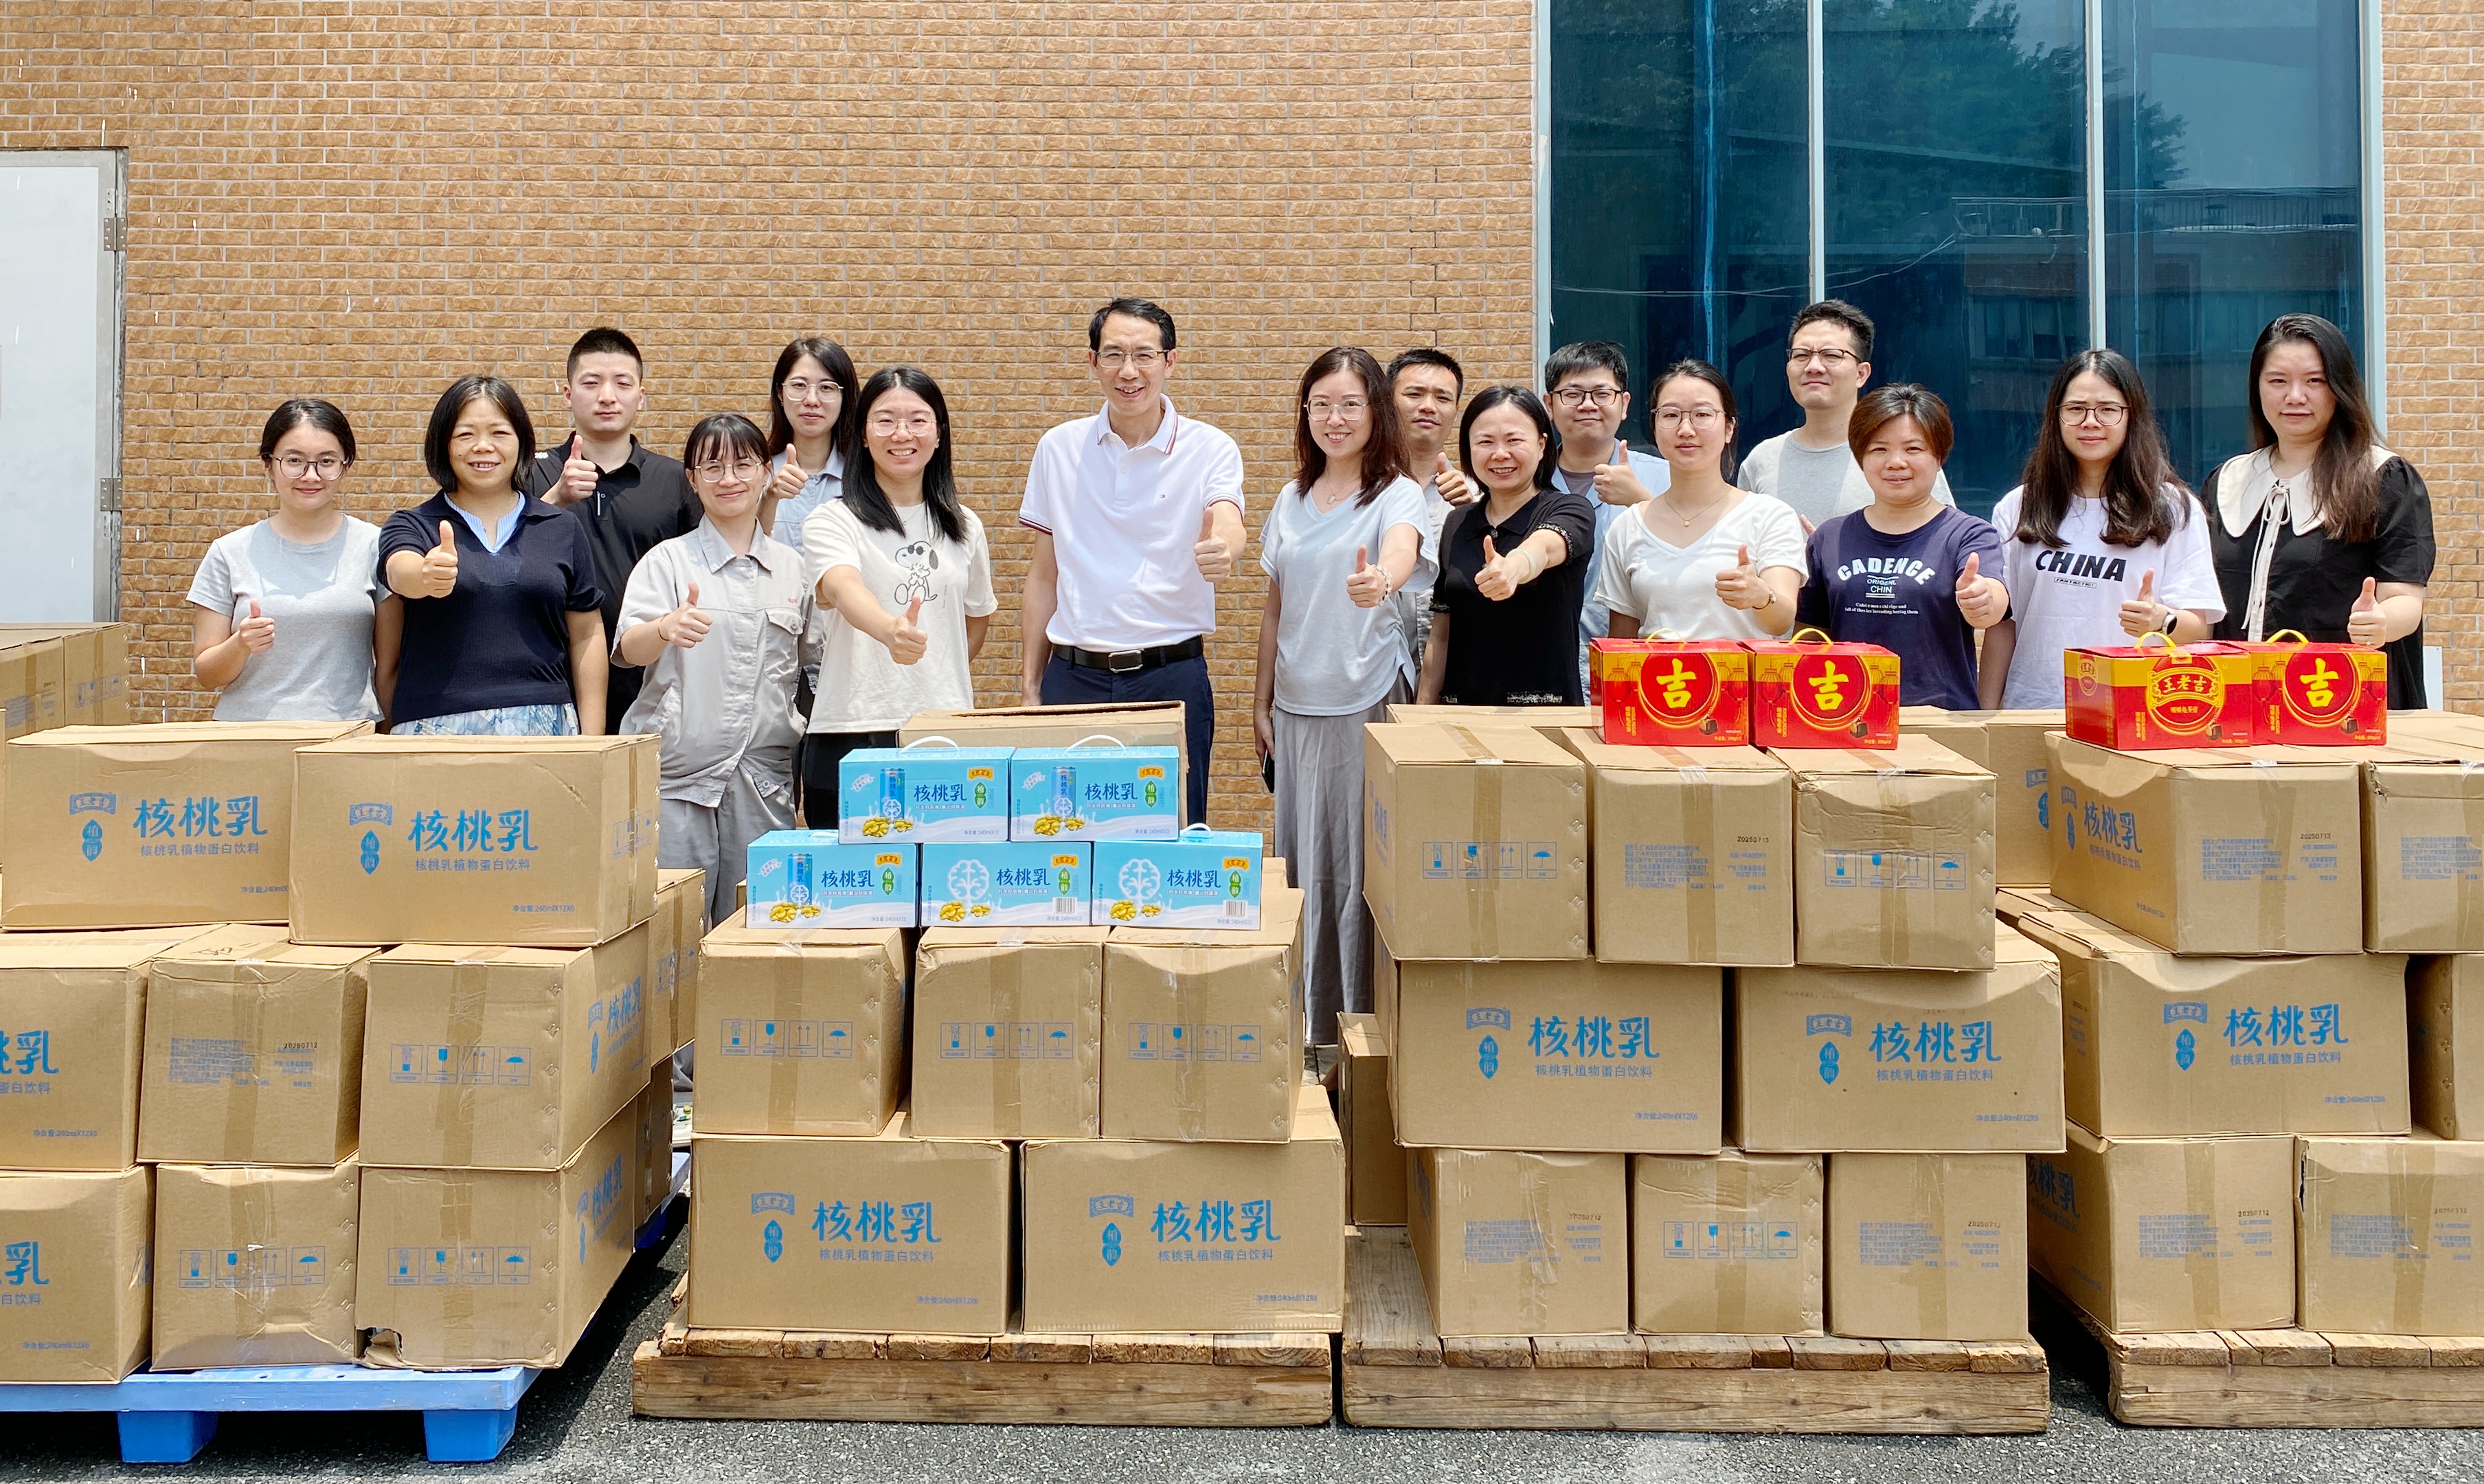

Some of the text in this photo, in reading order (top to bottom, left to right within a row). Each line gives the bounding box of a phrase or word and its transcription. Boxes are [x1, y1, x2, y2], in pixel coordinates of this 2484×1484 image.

[1838, 558, 1936, 585] CADENCE
[2035, 550, 2127, 582] CHINA
[1871, 585, 1893, 593] CHIN
[1656, 658, 1697, 709] 吉
[1808, 660, 1849, 711] 吉
[2163, 674, 2207, 694] 王老吉
[2299, 657, 2339, 708] 吉
[913, 784, 967, 803] 核桃乳
[1084, 783, 1138, 801] 核桃乳
[133, 796, 267, 837] 核桃乳
[408, 810, 537, 852] 核桃乳
[2084, 800, 2143, 854] 核桃乳
[141, 843, 258, 856] 核桃乳植物蛋白饮料
[415, 858, 530, 871] 核桃乳植物蛋白饮料
[821, 869, 874, 889] 核桃乳
[996, 868, 1050, 887] 核桃乳
[1167, 869, 1221, 888] 核桃乳
[2224, 1004, 2348, 1047] 核桃乳
[1528, 1016, 1659, 1058] 核桃乳
[1869, 1021, 2000, 1063] 核桃乳
[2230, 1051, 2340, 1065] 核桃乳植物蛋白饮料
[1535, 1064, 1651, 1077] 核桃乳植物蛋白饮料
[1877, 1069, 1993, 1081] 核桃乳植物蛋白饮料
[811, 1200, 940, 1244] 核桃乳
[1151, 1200, 1280, 1243] 核桃乳
[5, 1241, 49, 1286] 乳
[820, 1248, 933, 1262] 核桃乳植物蛋白饮料
[1158, 1248, 1272, 1261] 核桃乳植物蛋白饮料
[2, 1294, 40, 1304] 白饮料
